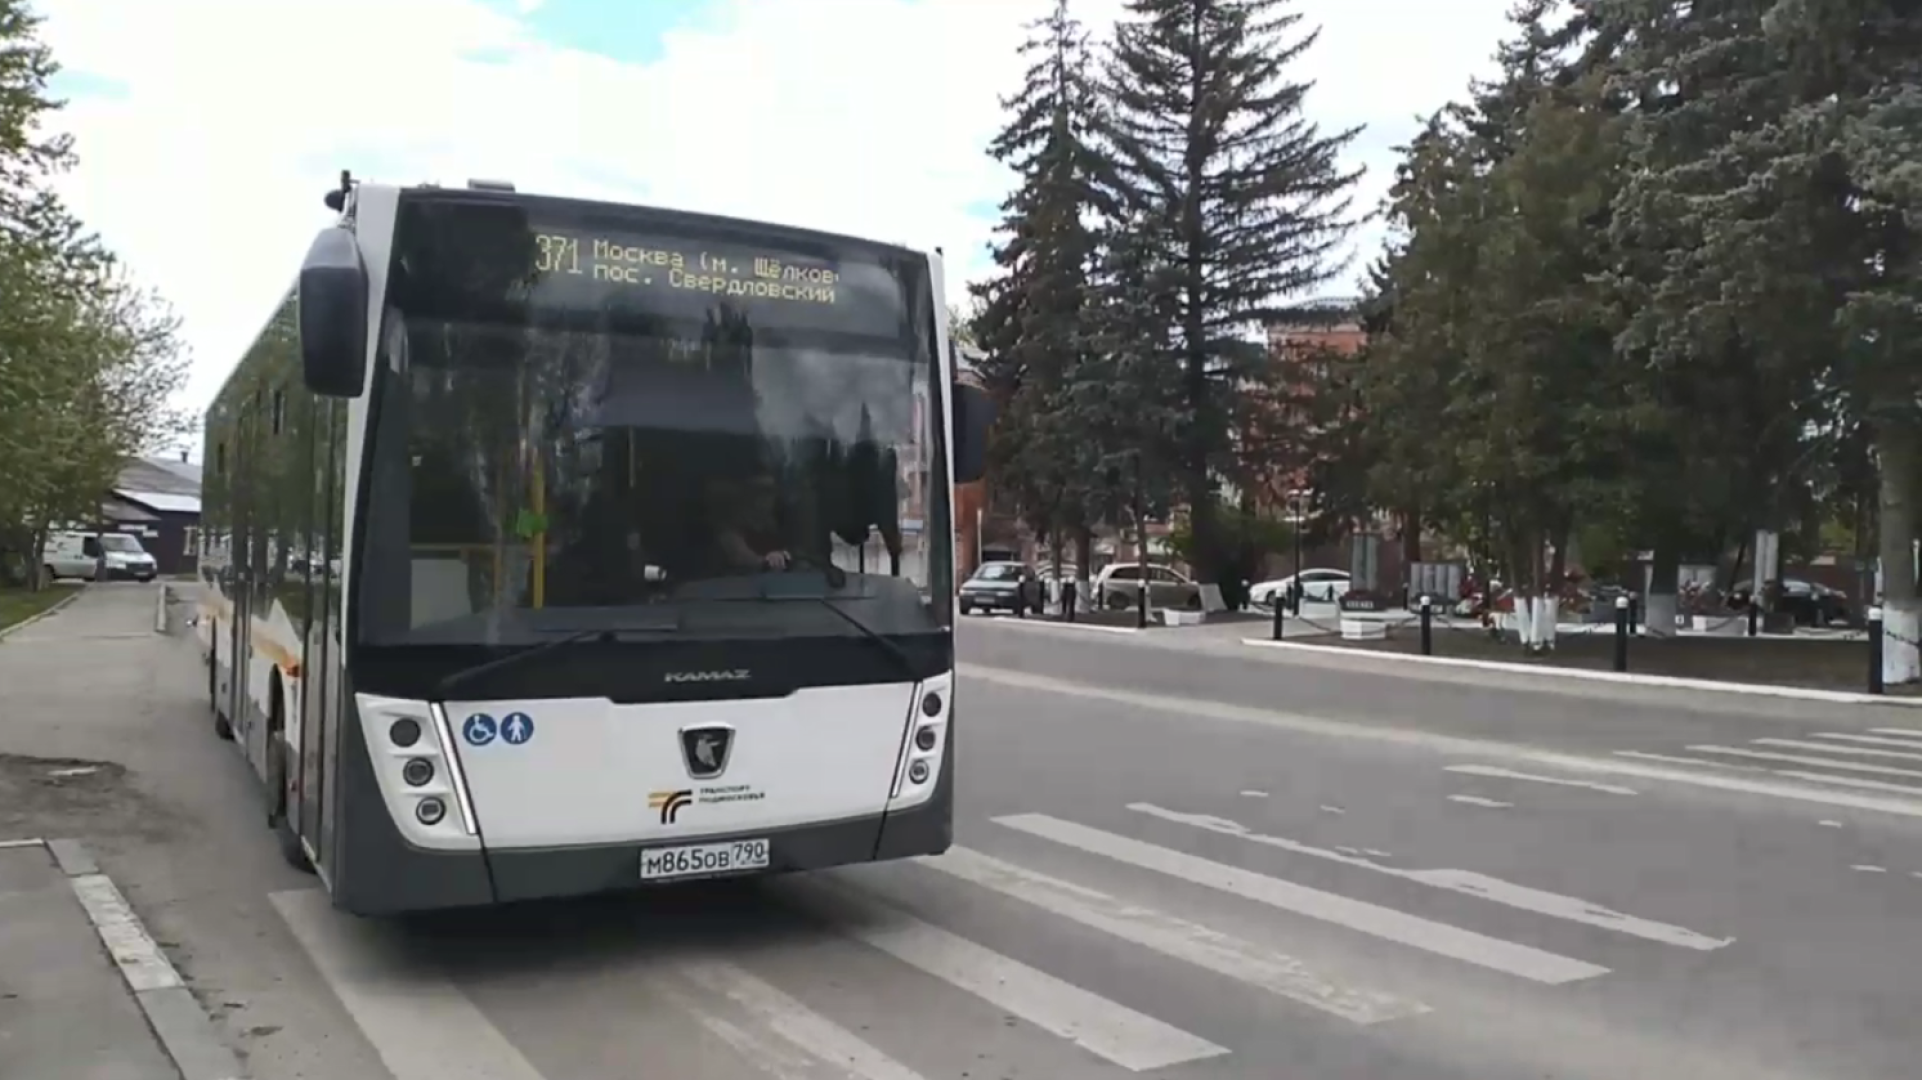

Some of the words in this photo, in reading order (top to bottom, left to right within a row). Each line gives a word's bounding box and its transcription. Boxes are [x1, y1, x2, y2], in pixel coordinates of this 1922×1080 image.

[535, 234, 583, 274] 371
[593, 238, 685, 269] Москва
[669, 268, 836, 303] Свердловский
[664, 669, 751, 682] KAMAZ
[733, 843, 765, 861] 790
